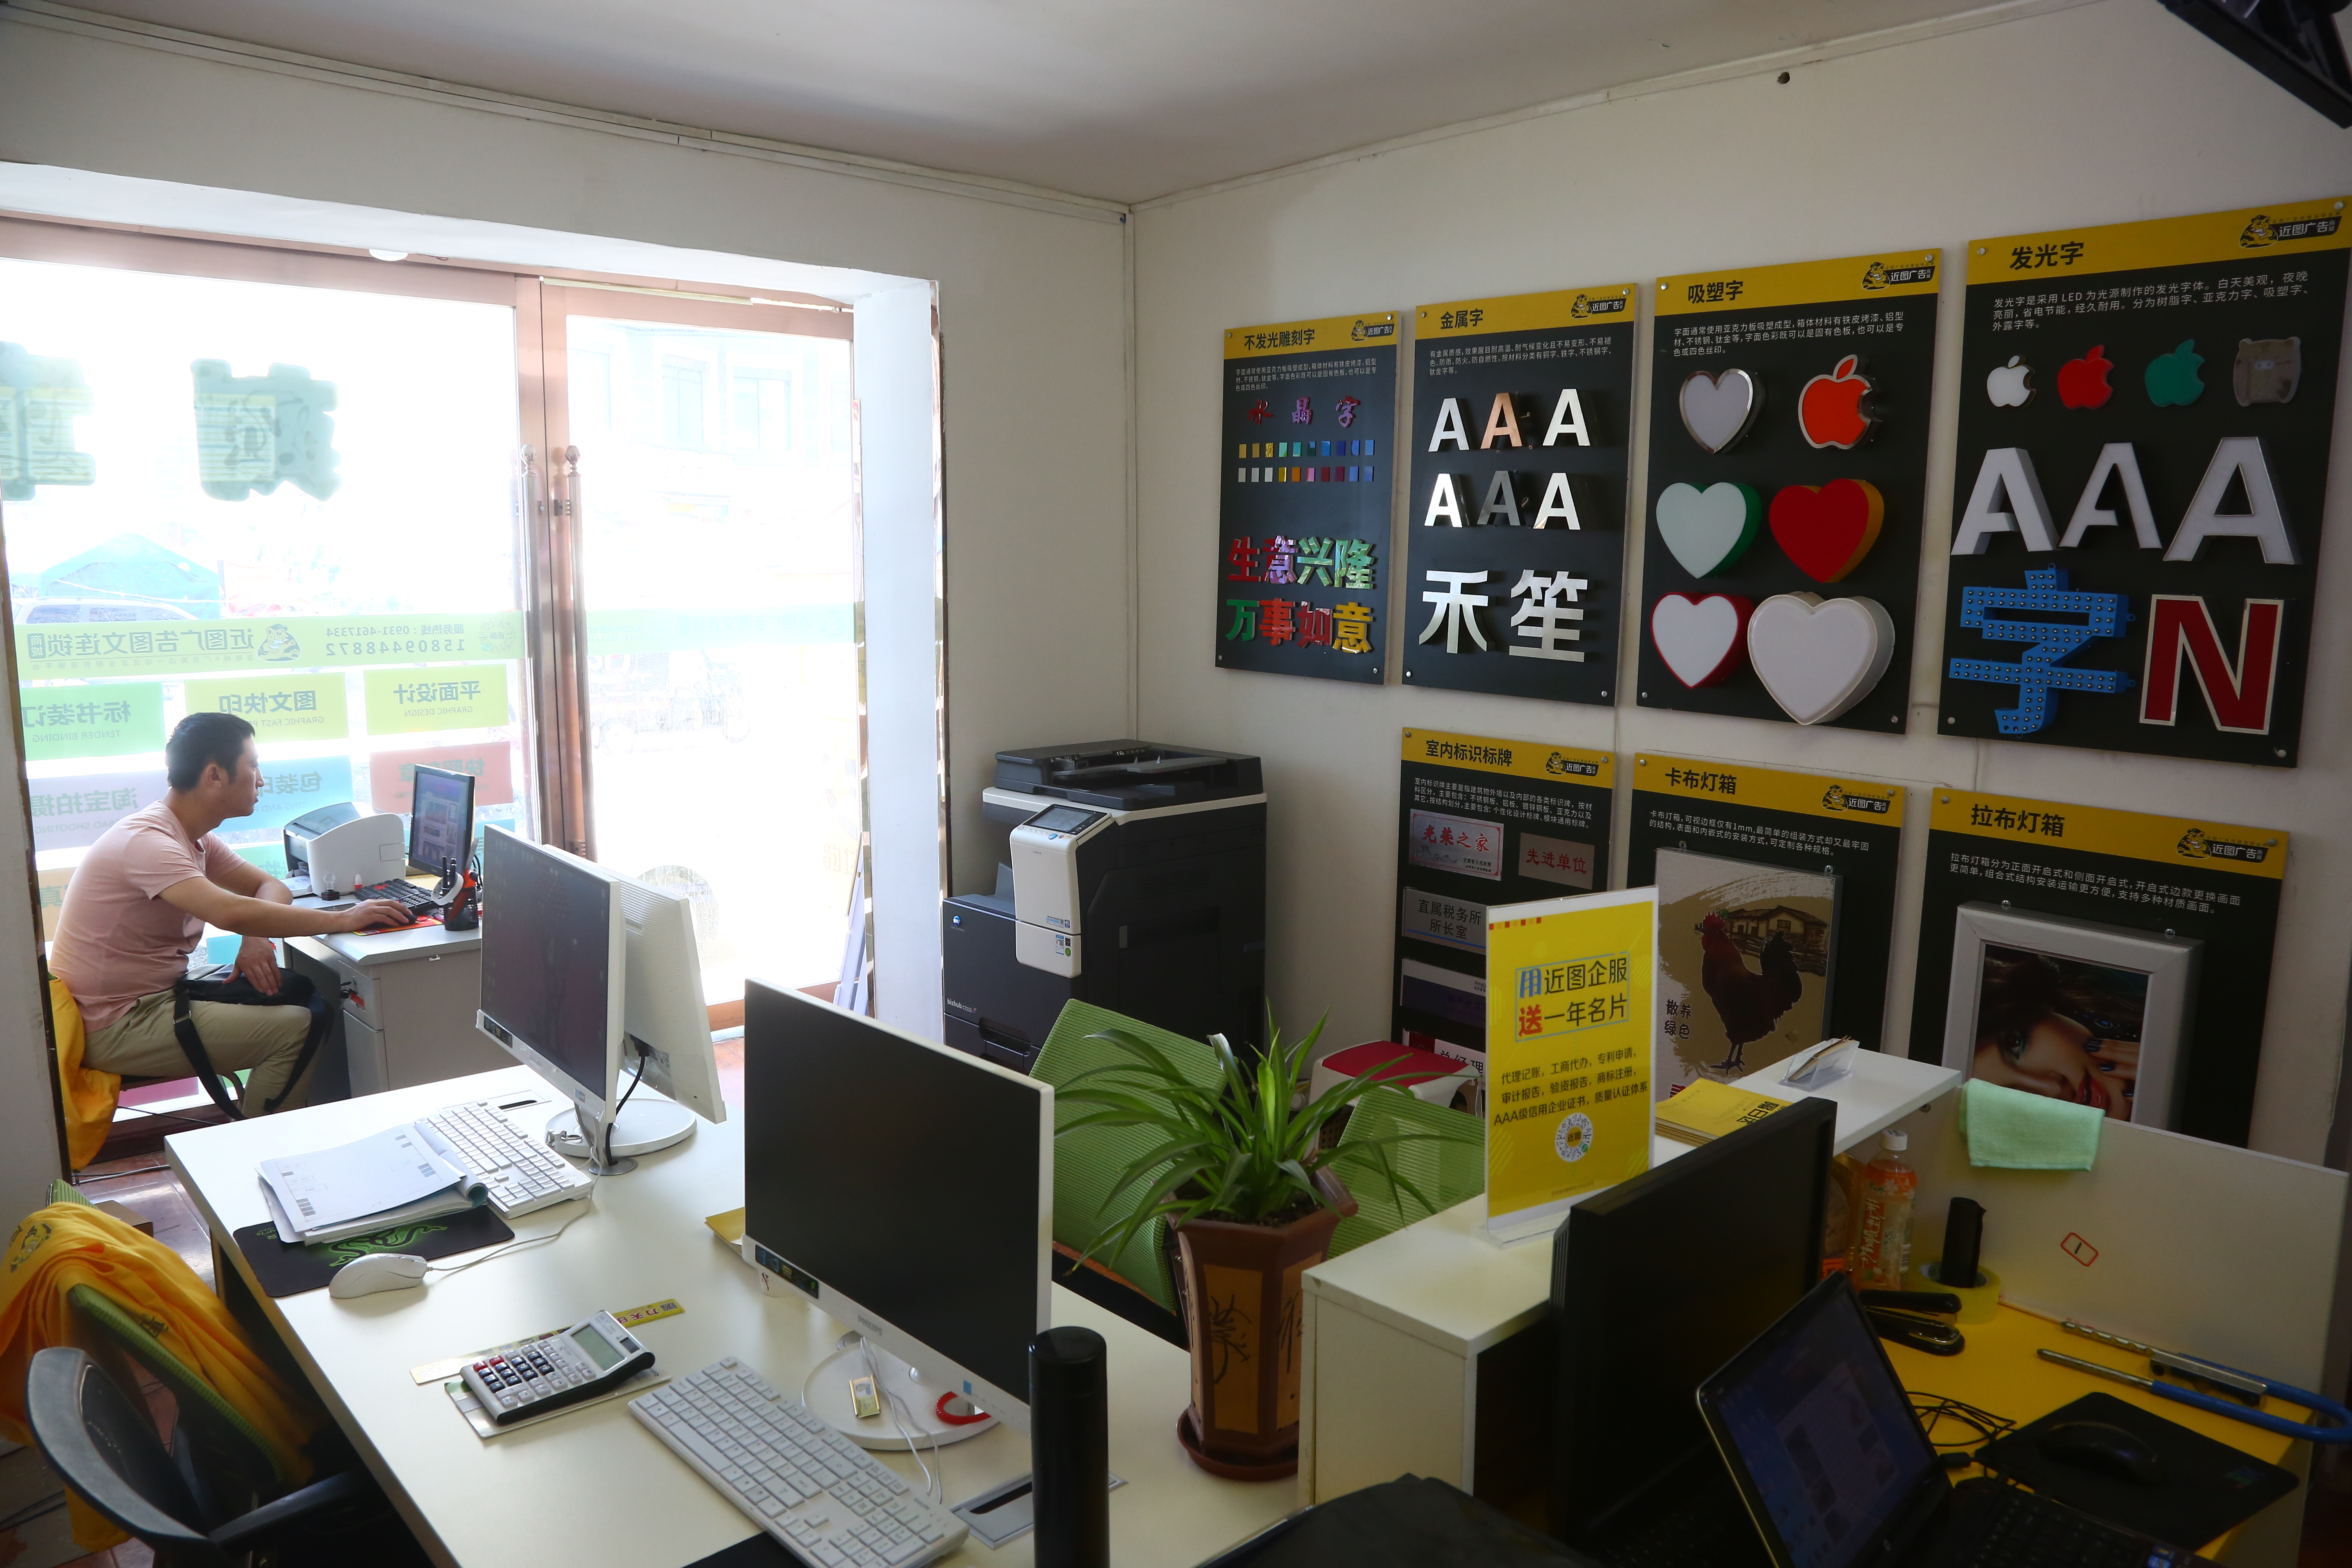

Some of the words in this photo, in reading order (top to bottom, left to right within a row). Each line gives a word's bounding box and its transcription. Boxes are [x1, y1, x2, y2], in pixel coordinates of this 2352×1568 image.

[2279, 221, 2329, 237] 近图广告
[2009, 241, 2084, 271] 发光字
[1891, 269, 1926, 282] 近图广告
[1688, 280, 1744, 305] 吸塑字
[1993, 292, 2059, 309] 发光字是采用
[2061, 292, 2082, 303] LED
[1592, 301, 1619, 311] 近图广告
[1440, 308, 1484, 330] 金属字
[1992, 318, 2041, 332] 外露字等。
[1244, 328, 1316, 350] 不发光雕刻字
[1368, 326, 1389, 335] 近图广告
[1673, 345, 1726, 356] 色或四色丝印。
[1430, 367, 1458, 376] 钛金字等。
[1227, 535, 1374, 589] 生意兴隆
[1225, 598, 1373, 654] 万事如意
[1419, 569, 1588, 663] 禾笙
[2138, 593, 2285, 735] N
[1425, 739, 1513, 767] 室内标识标牌
[1566, 763, 1592, 774] 近图广告
[1665, 767, 1737, 795] 卡布灯箱
[1848, 797, 1882, 811] 近图广告
[1971, 804, 2065, 838] 拉布灯箱
[1422, 824, 1490, 853] 光荣之家
[1526, 848, 1587, 874] 先进单位
[2212, 843, 2257, 859] 近图广告
[1417, 899, 1482, 925] 直属税务所
[1429, 918, 1468, 940] 所长室
[1519, 957, 1628, 998] 用近图企服
[947, 998, 962, 1009] bizhub
[1666, 999, 1692, 1020] 散养
[1518, 993, 1628, 1037] 送一年名片
[1664, 1020, 1690, 1040] 绿色
